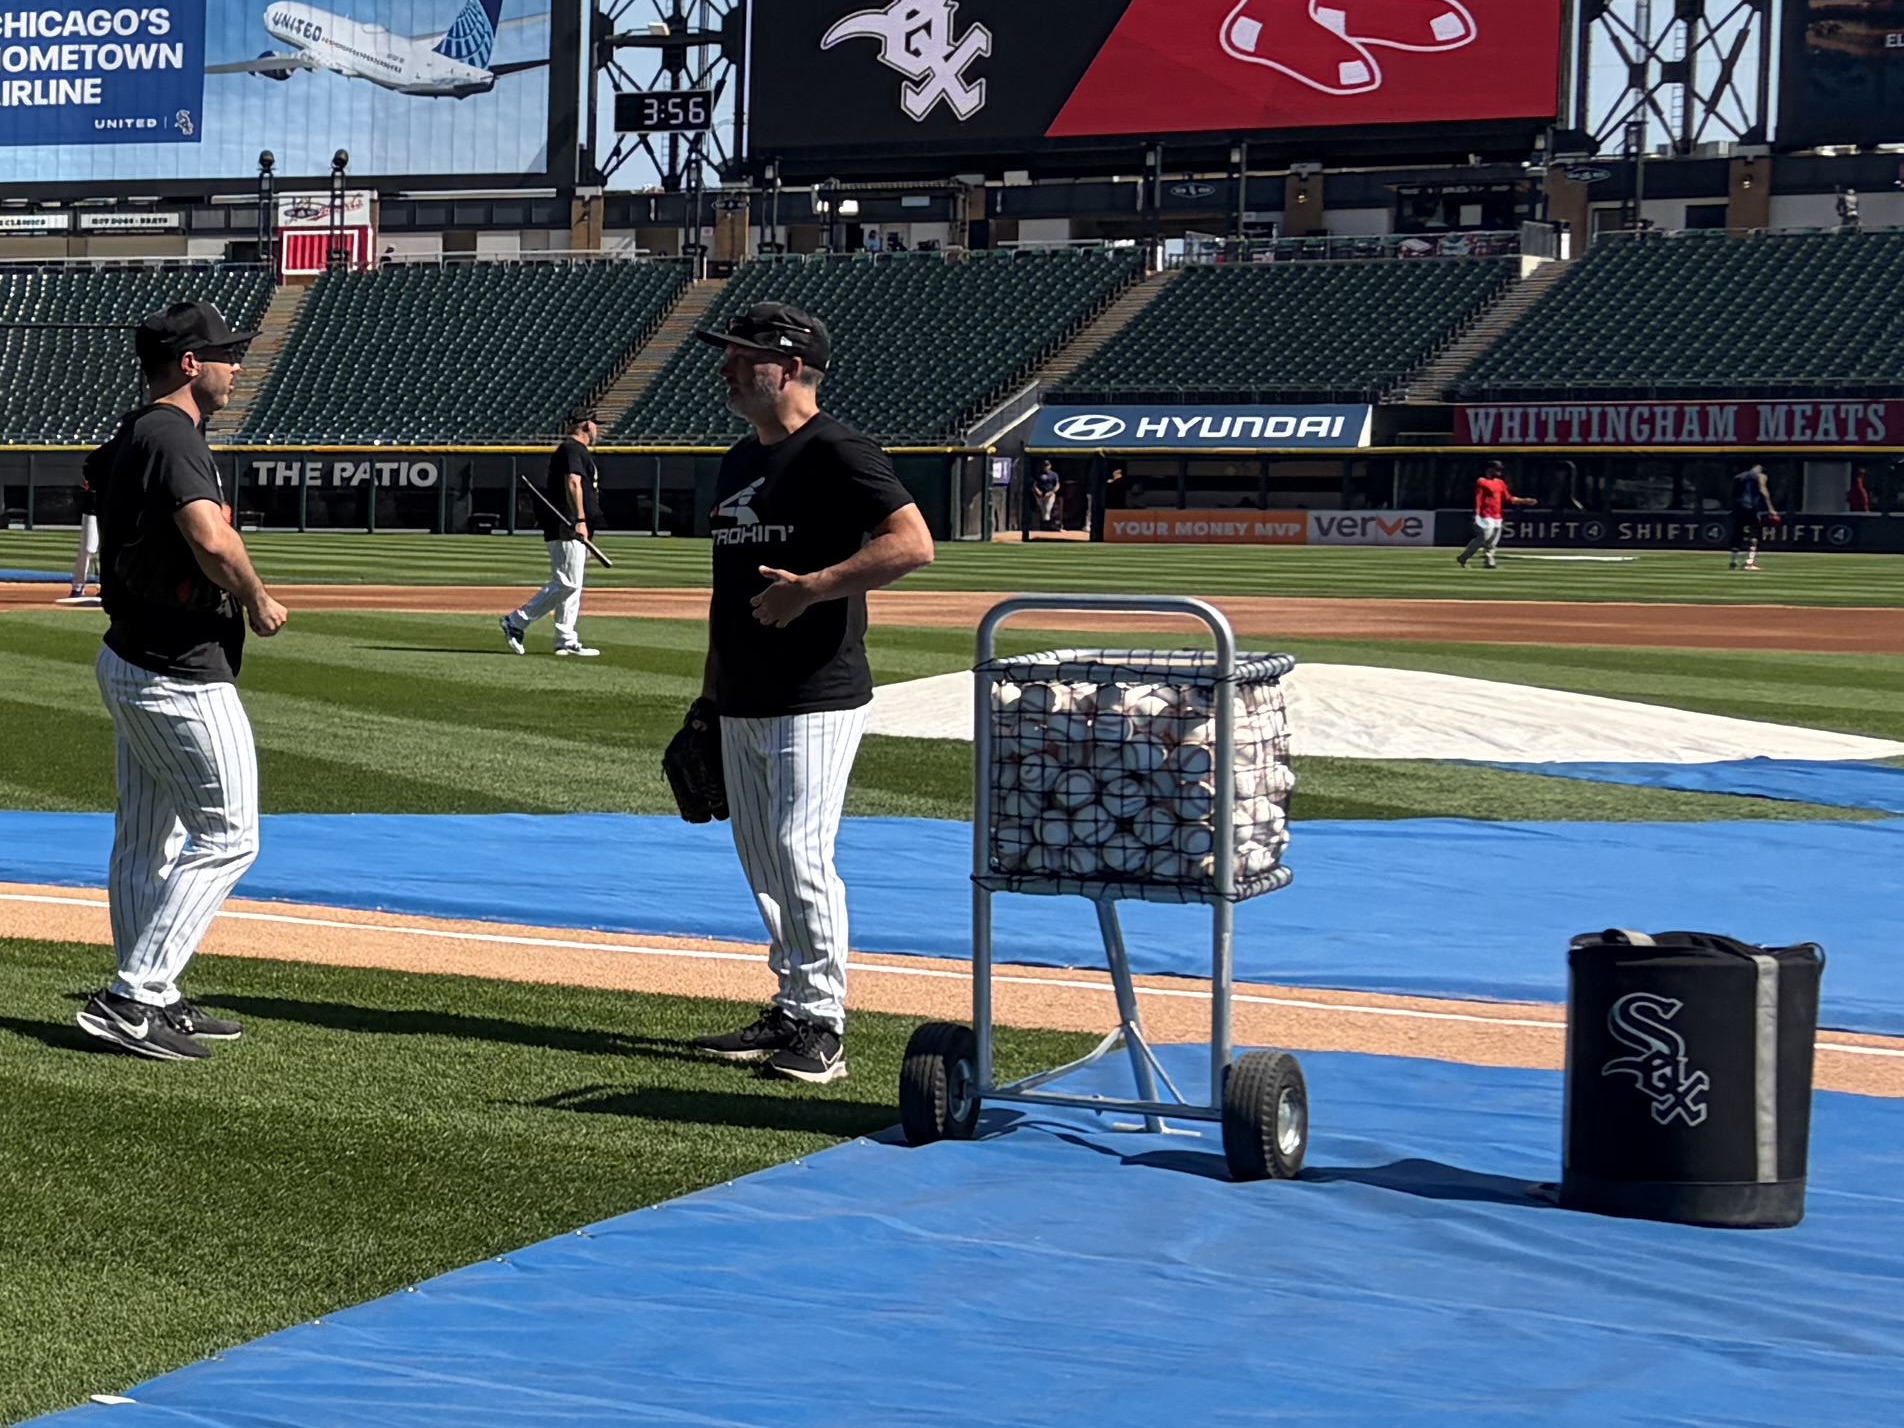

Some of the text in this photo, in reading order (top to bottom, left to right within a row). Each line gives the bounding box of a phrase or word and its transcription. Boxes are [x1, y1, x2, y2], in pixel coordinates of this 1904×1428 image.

[271, 10, 323, 42] UNITED
[94, 118, 157, 129] UNITED
[644, 97, 705, 125] 3:56
[1136, 416, 1346, 438] HYUNDAI
[1467, 403, 1886, 445] WHITTINGHAM MEATS
[253, 461, 437, 488] THE PATIO
[1113, 521, 1302, 537] YOUR MONEY MVP
